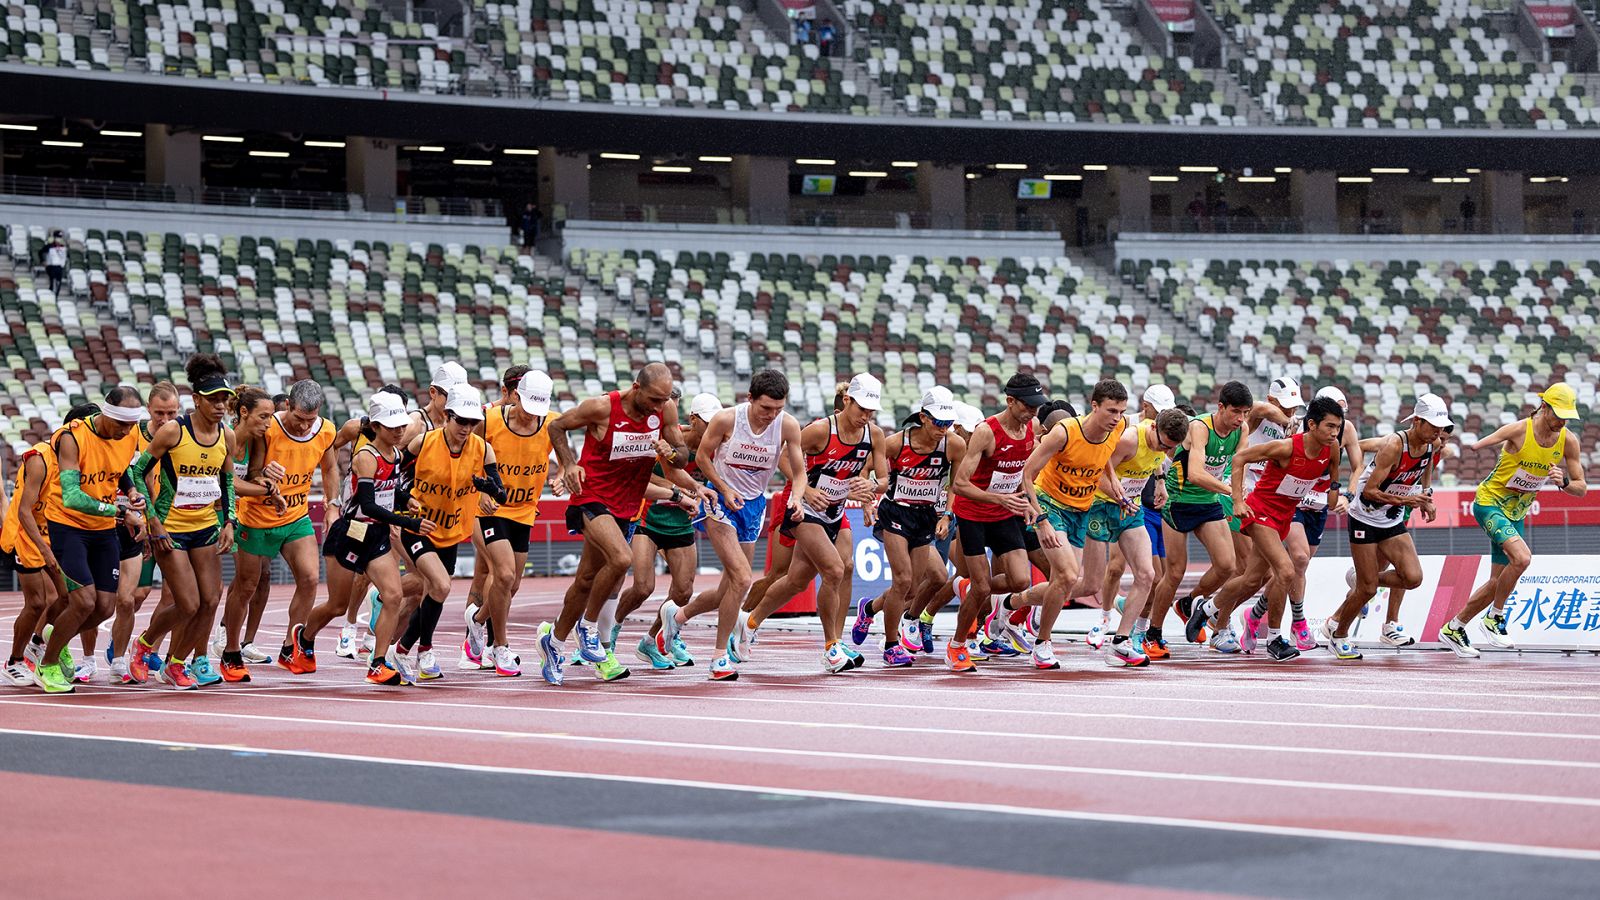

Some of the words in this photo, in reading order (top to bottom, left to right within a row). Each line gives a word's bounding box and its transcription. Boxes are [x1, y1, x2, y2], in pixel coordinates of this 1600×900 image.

[613, 444, 656, 453] NASRALLA
[740, 443, 768, 453] TOYOTA
[732, 451, 770, 463] GAVRILOV
[179, 464, 221, 476] BRASIL
[497, 462, 521, 476] KYO
[523, 462, 547, 476] 2020
[821, 458, 863, 473] JAPAN
[998, 460, 1025, 468] MOROC
[1055, 461, 1094, 477] TOKYO
[1519, 460, 1550, 471] AUSTRAL
[900, 465, 943, 478] JAPAN
[897, 484, 937, 497] KUMAGAI
[1294, 486, 1306, 494] LI
[1520, 575, 1551, 584] SHIMIZU
